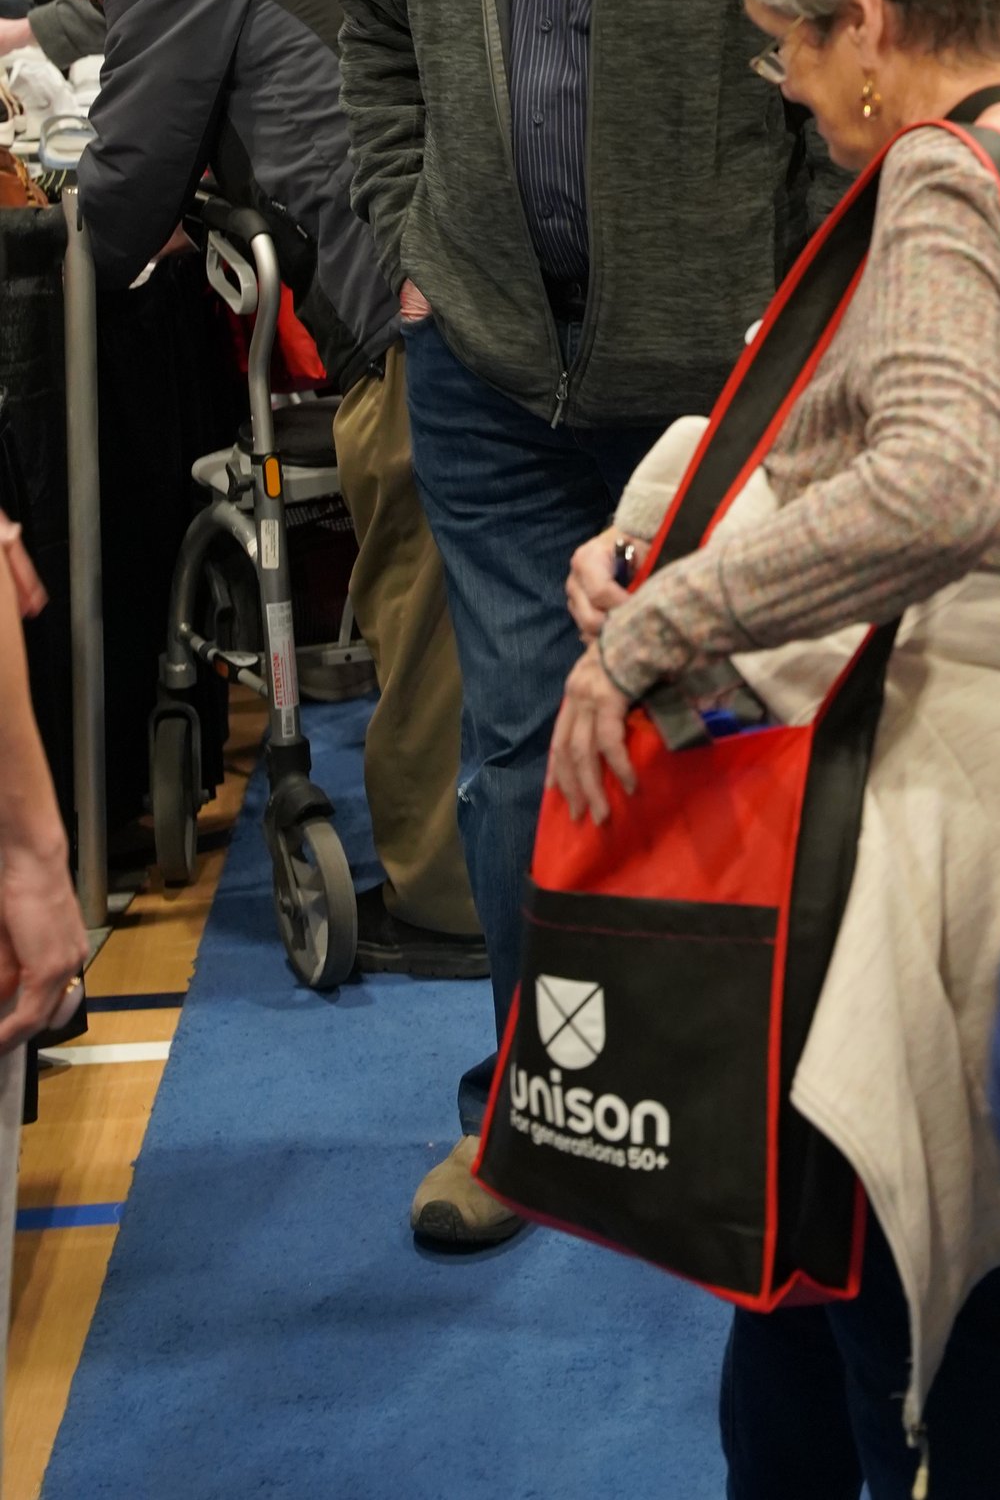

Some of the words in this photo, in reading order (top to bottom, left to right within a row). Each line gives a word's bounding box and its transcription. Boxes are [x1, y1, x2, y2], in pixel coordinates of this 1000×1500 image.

[510, 1062, 670, 1148] unison
[531, 1120, 627, 1168] generations
[627, 1146, 670, 1172] 50+
